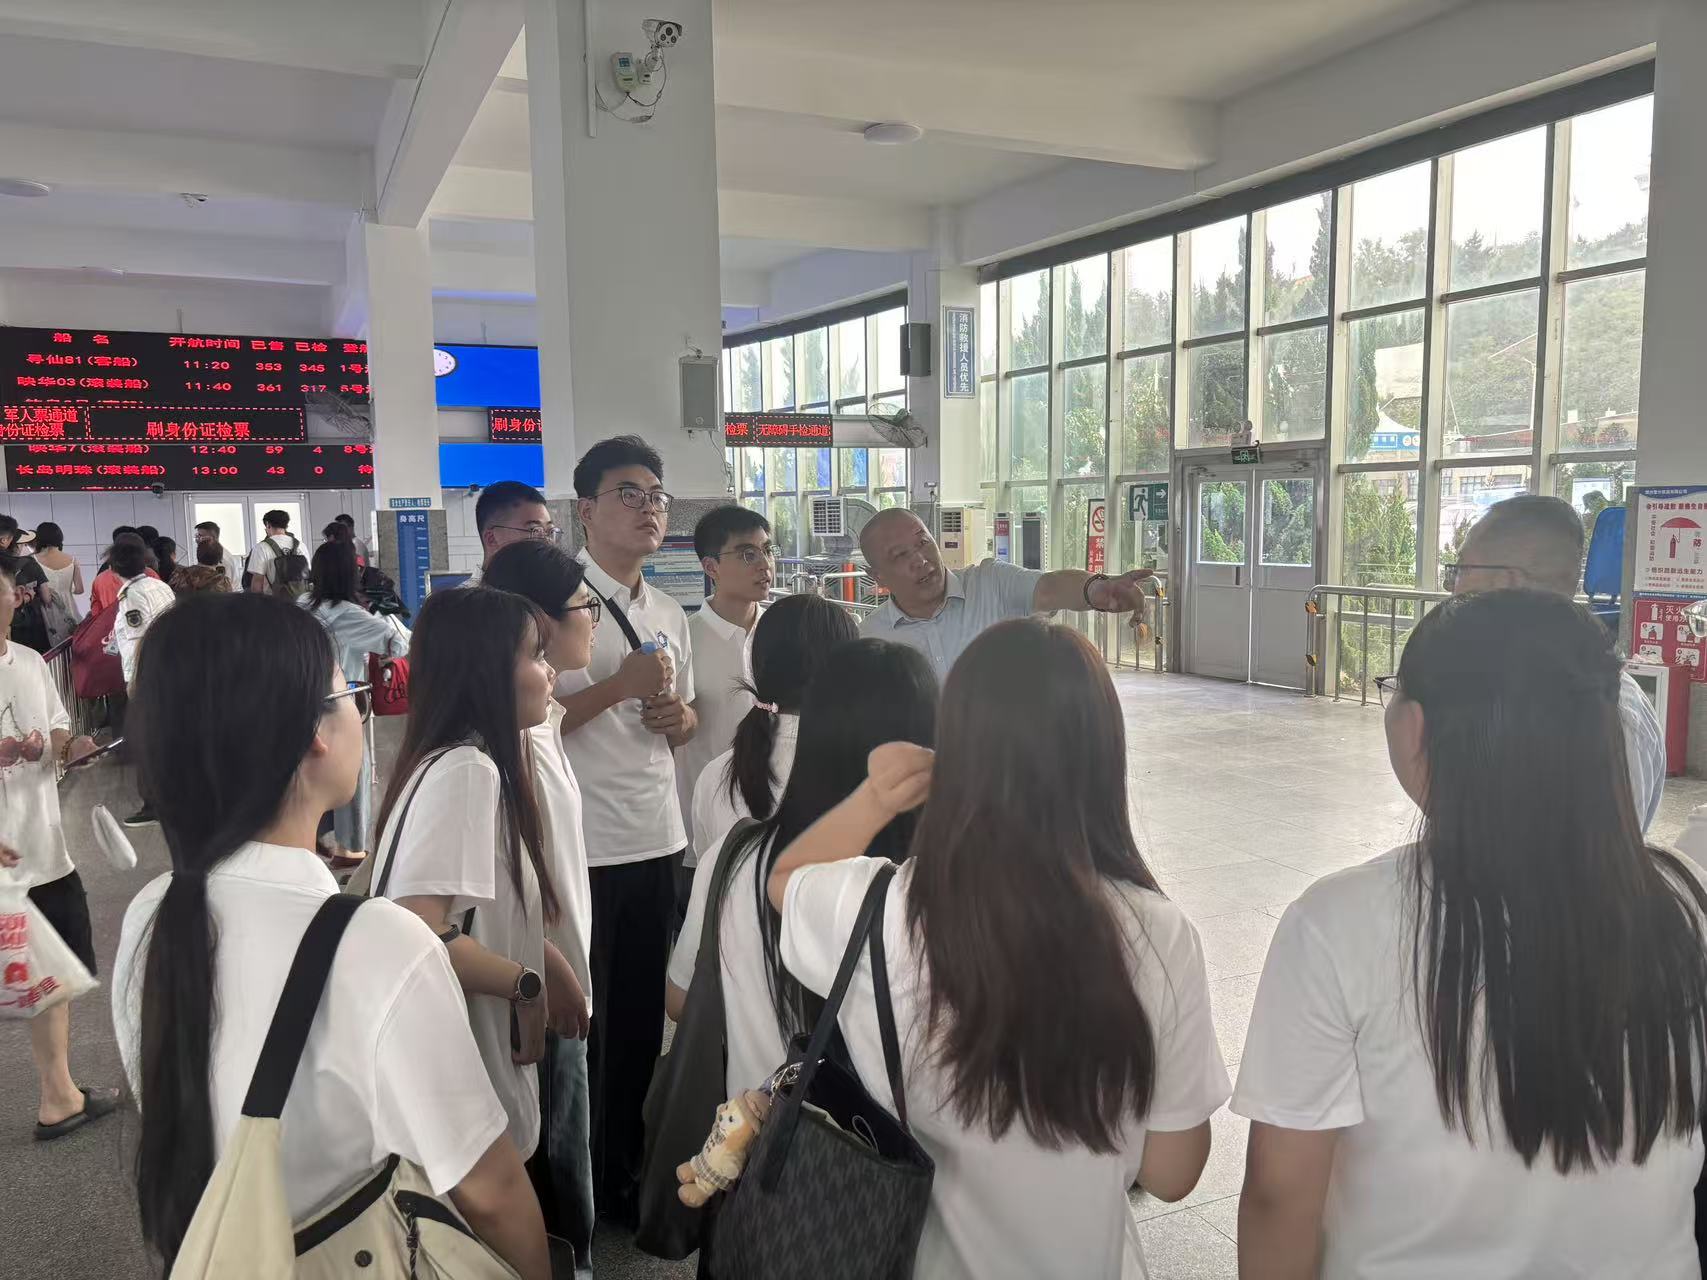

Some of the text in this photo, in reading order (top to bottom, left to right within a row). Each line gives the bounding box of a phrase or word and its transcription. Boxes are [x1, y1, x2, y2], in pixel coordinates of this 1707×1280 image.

[168, 336, 240, 350] 开航时间
[251, 339, 285, 351] 已售
[294, 341, 328, 353] 已检
[184, 360, 230, 370] 11:20
[255, 362, 283, 371] 353
[299, 364, 326, 373] 345
[339, 363, 369, 374] 1号
[184, 381, 232, 391] 11:40
[256, 383, 283, 392] 361
[300, 384, 327, 394] 317
[4, 408, 79, 423] 军人票通道
[146, 421, 251, 438] 刷身份证检票
[725, 422, 749, 437] 检票
[190, 445, 237, 455] 12:40
[264, 445, 284, 455] 59
[312, 445, 323, 455] 4
[191, 465, 239, 475] 13:00
[266, 465, 286, 475] 43
[313, 465, 325, 475] 0
